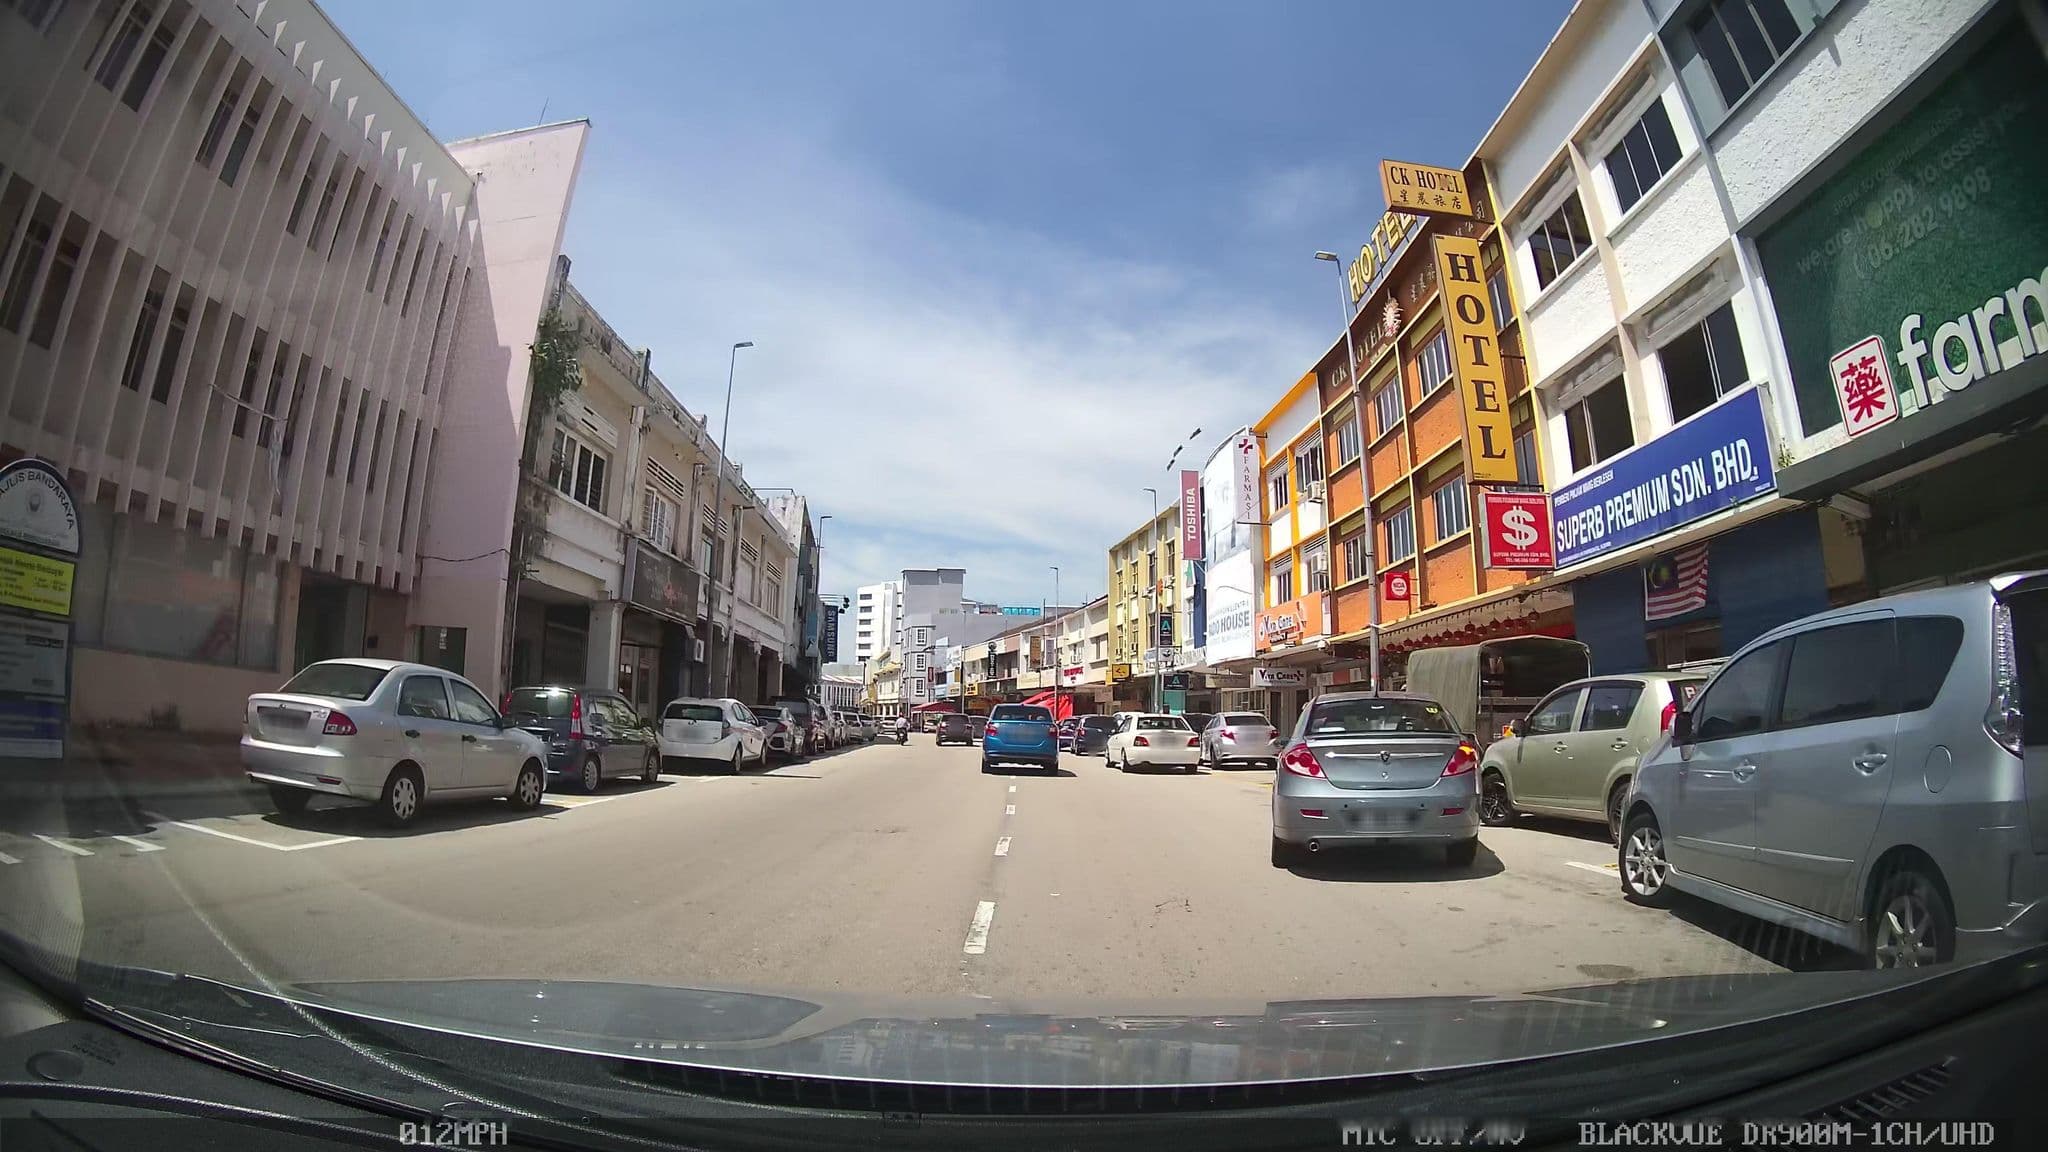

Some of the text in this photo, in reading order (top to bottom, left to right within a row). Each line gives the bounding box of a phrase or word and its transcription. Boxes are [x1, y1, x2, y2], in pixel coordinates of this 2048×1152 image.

[1390, 166, 1463, 194] CK HOTEL
[1939, 165, 1992, 219] 9898
[1348, 211, 1416, 304] HOTEL
[1825, 226, 1850, 256] are
[1332, 363, 1347, 387] CK
[1354, 322, 1385, 366] OTEL
[1444, 252, 1507, 459] HOTEL
[1840, 356, 1885, 423] 藥
[1186, 487, 1197, 541] TOSHIBA
[1243, 456, 1252, 520] FARMASI
[1557, 504, 1605, 553] SUPERB
[1605, 473, 1671, 535] PREMIUM
[1671, 457, 1711, 507] SDN.
[1711, 438, 1758, 491] BHD.
[827, 610, 836, 657] SAMSUNG
[1220, 610, 1250, 632] HOUSE
